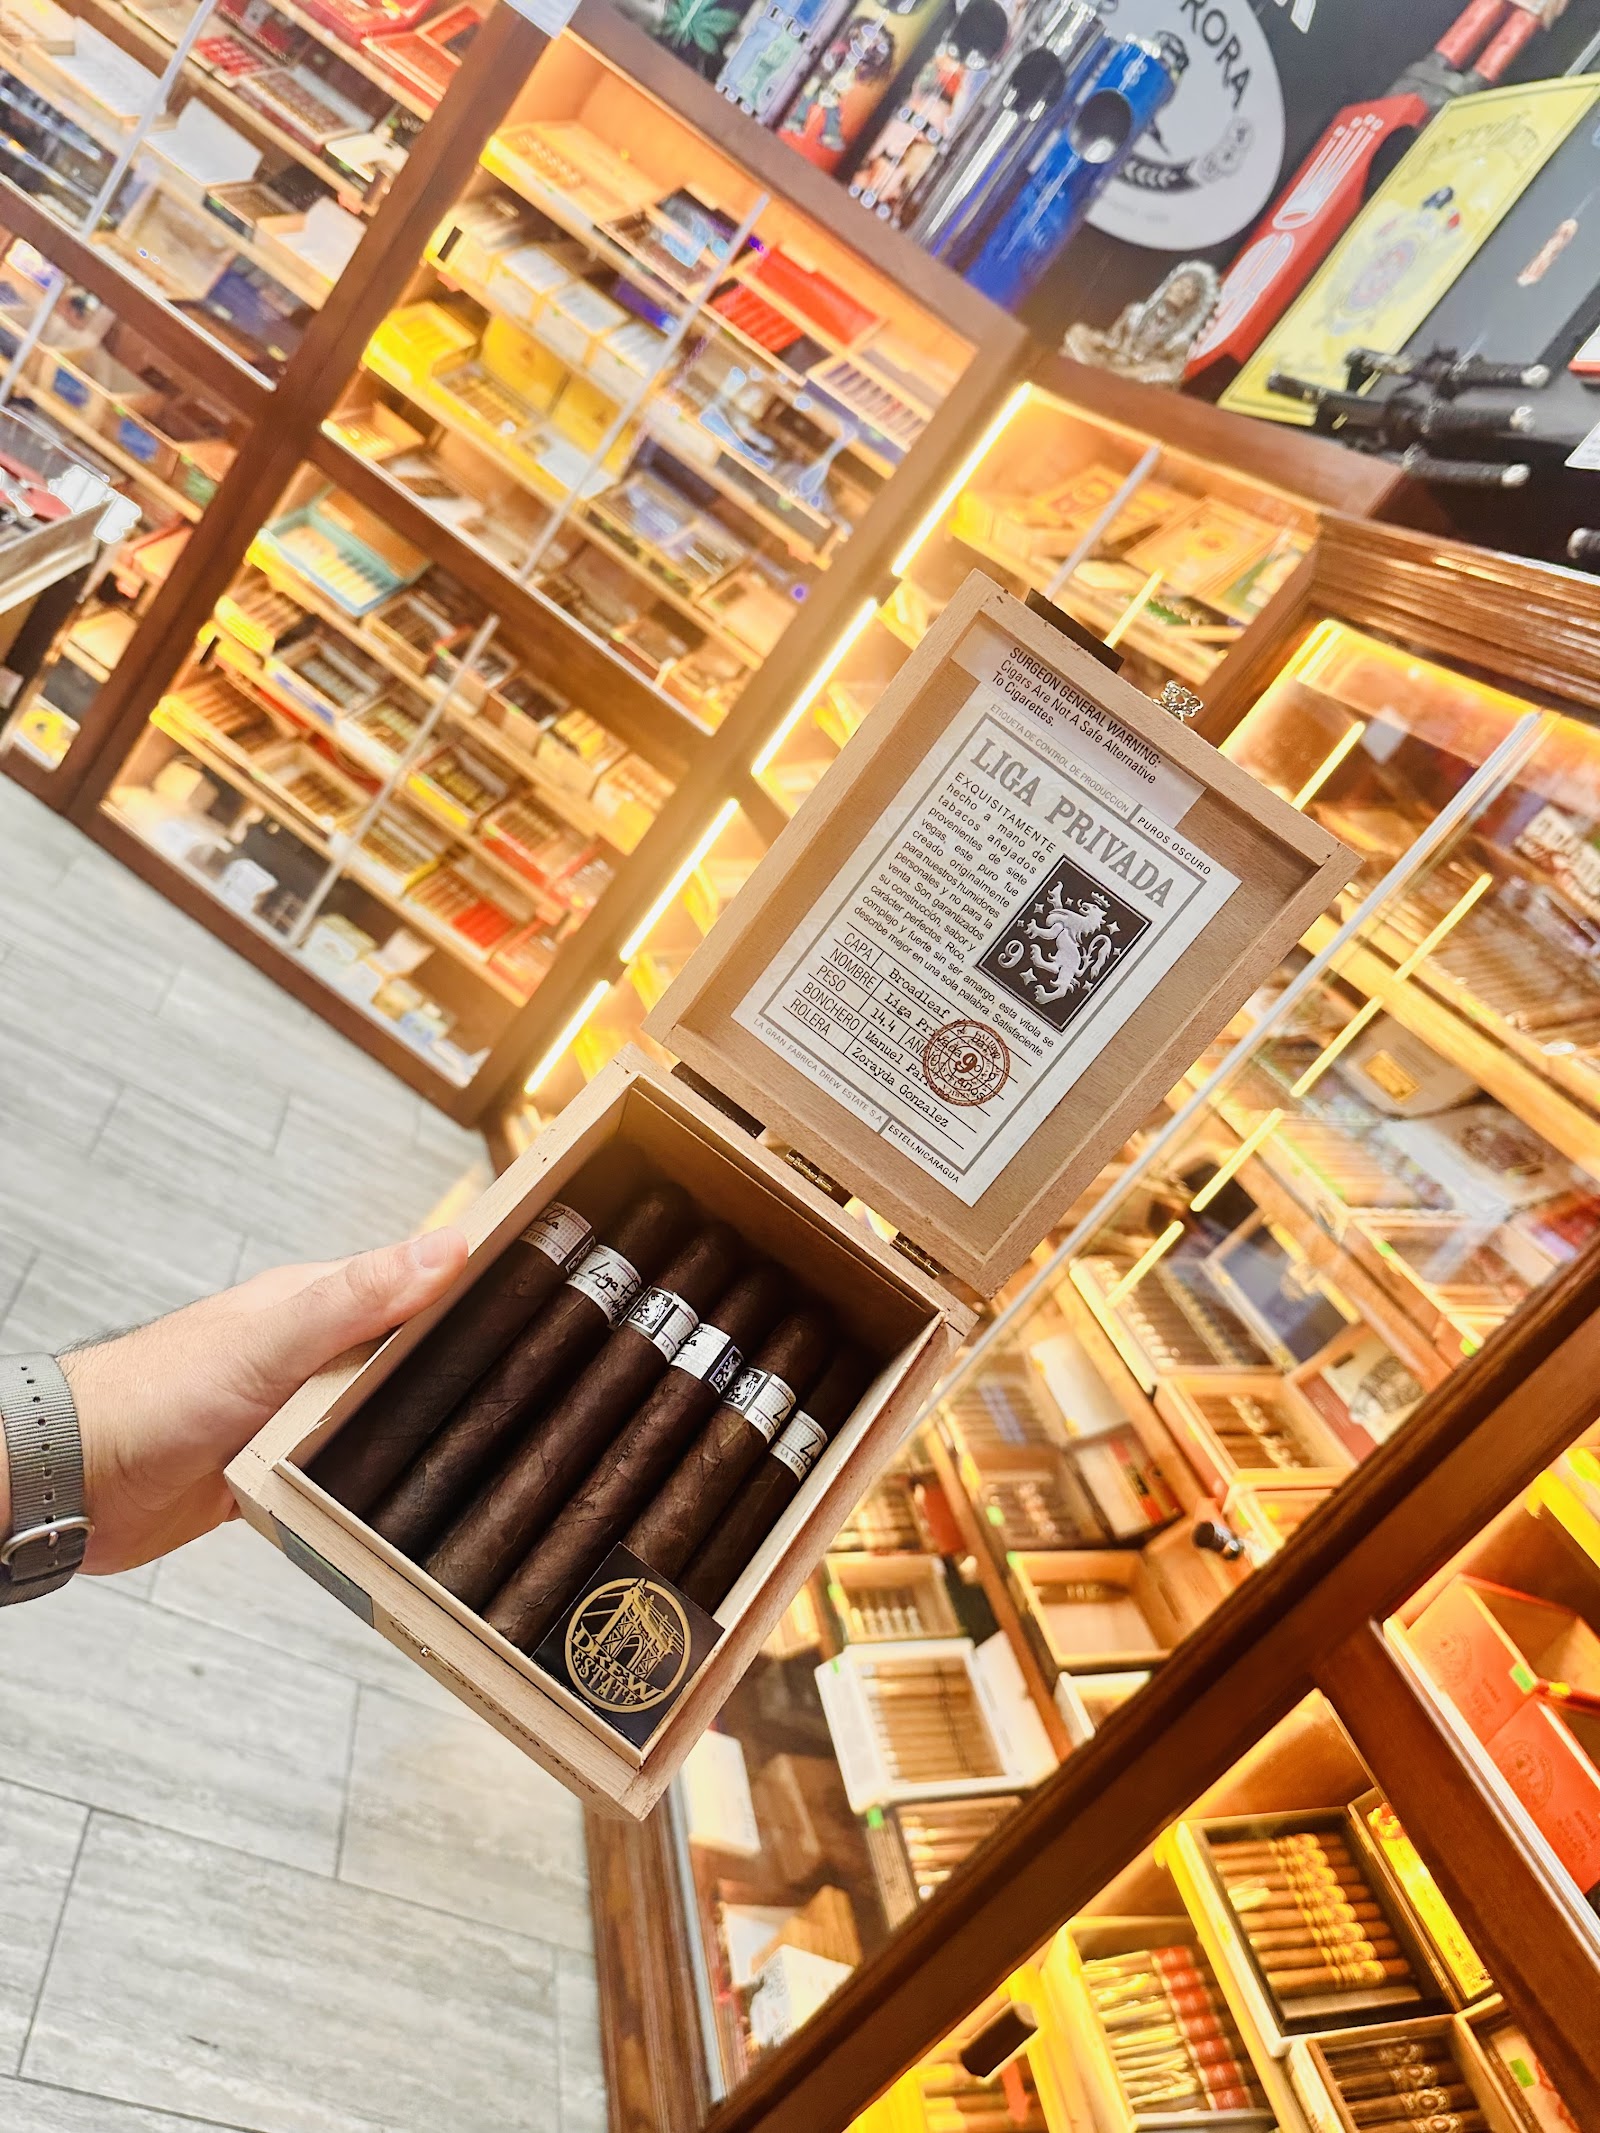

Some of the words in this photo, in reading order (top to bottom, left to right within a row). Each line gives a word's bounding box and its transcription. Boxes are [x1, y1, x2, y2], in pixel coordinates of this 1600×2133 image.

[992, 670, 1004, 686] To
[1004, 681, 1053, 726] Cigarettes.
[1000, 659, 1032, 688] Cigars
[1030, 684, 1050, 703] Are
[1050, 697, 1071, 718] Not
[1068, 713, 1079, 725] A
[1079, 720, 1102, 743] Safe
[1101, 739, 1155, 783] Alternative
[1009, 647, 1061, 690] SURGEON
[1059, 684, 1106, 727] GENERAL
[1106, 720, 1161, 767] WARNING:
[990, 703, 1024, 733] ETIQUETA
[1023, 729, 1036, 741] DE
[1035, 738, 1068, 768] CONTROL
[1068, 764, 1081, 776] DE
[1079, 772, 1129, 812] PRODUCCION
[927, 807, 982, 850] provenientes
[988, 853, 1000, 864] de
[1005, 866, 1027, 885] siete
[938, 794, 980, 831] tabacos
[986, 834, 1036, 874] añejados
[946, 782, 977, 810] hecho
[983, 813, 991, 821] a
[997, 823, 1025, 847] mano
[1031, 850, 1045, 862] de
[954, 771, 1056, 853] EXQUISITAMENTE
[970, 737, 1040, 807] LIGA
[1043, 794, 1173, 908] PRIVADA
[1137, 816, 1170, 843] PUROS
[1171, 842, 1210, 874] OSCURO
[894, 851, 939, 888] personales
[939, 886, 948, 895] y
[948, 893, 961, 904] no
[960, 903, 982, 921] para
[983, 917, 992, 929] la
[901, 841, 923, 858] para
[922, 855, 957, 885] nuestros
[956, 880, 1000, 918] humidores
[912, 830, 943, 856] creado
[949, 859, 1009, 907] originalmente
[921, 818, 946, 843] vegas,
[954, 845, 973, 861] este
[976, 863, 998, 880] puro
[1003, 881, 1018, 896] fue
[870, 885, 904, 912] carácter
[902, 911, 941, 944] perfectos.
[944, 941, 964, 963] Rico,
[878, 873, 890, 885] su
[891, 883, 941, 927] construcción,
[943, 924, 968, 944] sabor
[966, 943, 976, 951] y
[888, 862, 911, 886] venta.
[914, 882, 931, 899] Son
[931, 898, 984, 940] garantizados
[829, 947, 877, 989] NOMBRE
[884, 991, 911, 1018] Liga
[843, 932, 872, 960] CAPA
[888, 967, 950, 1018] Broadleaf
[854, 906, 887, 935] describe
[887, 933, 912, 953] mejor
[912, 952, 923, 963] en
[923, 961, 940, 976] una
[940, 974, 958, 990] sola
[991, 1013, 1043, 1059] Satisfaciente.
[862, 896, 898, 926] complejo
[897, 924, 907, 933] y
[907, 930, 931, 952] fuerte
[933, 951, 946, 964] sin
[947, 962, 963, 975] ser
[963, 975, 995, 1004] amargo,
[998, 1002, 1017, 1019] esta
[1019, 1017, 1041, 1037] vitola
[1042, 1036, 1053, 1047] se
[998, 939, 1025, 969] 9
[802, 981, 860, 1030] BONCHERO
[864, 1029, 903, 1064] Manuel
[816, 964, 846, 991] PESO
[870, 1007, 895, 1032] 14.4
[753, 1018, 763, 1029] LA
[765, 1027, 786, 1046] GRAN
[786, 1044, 817, 1071] FABRICA
[818, 1069, 841, 1089] DREW
[841, 1087, 868, 1110] ESTATE
[790, 997, 830, 1035] ROLERA
[851, 1047, 894, 1085] Zorayda
[899, 1084, 948, 1127] Gonzalez
[955, 1053, 978, 1073] 9
[587, 1260, 617, 1292] Liga
[753, 1414, 764, 1425] LA
[779, 1447, 790, 1457] LA
[569, 1620, 665, 1702] DREW
[572, 1647, 640, 1706] ESTATE
